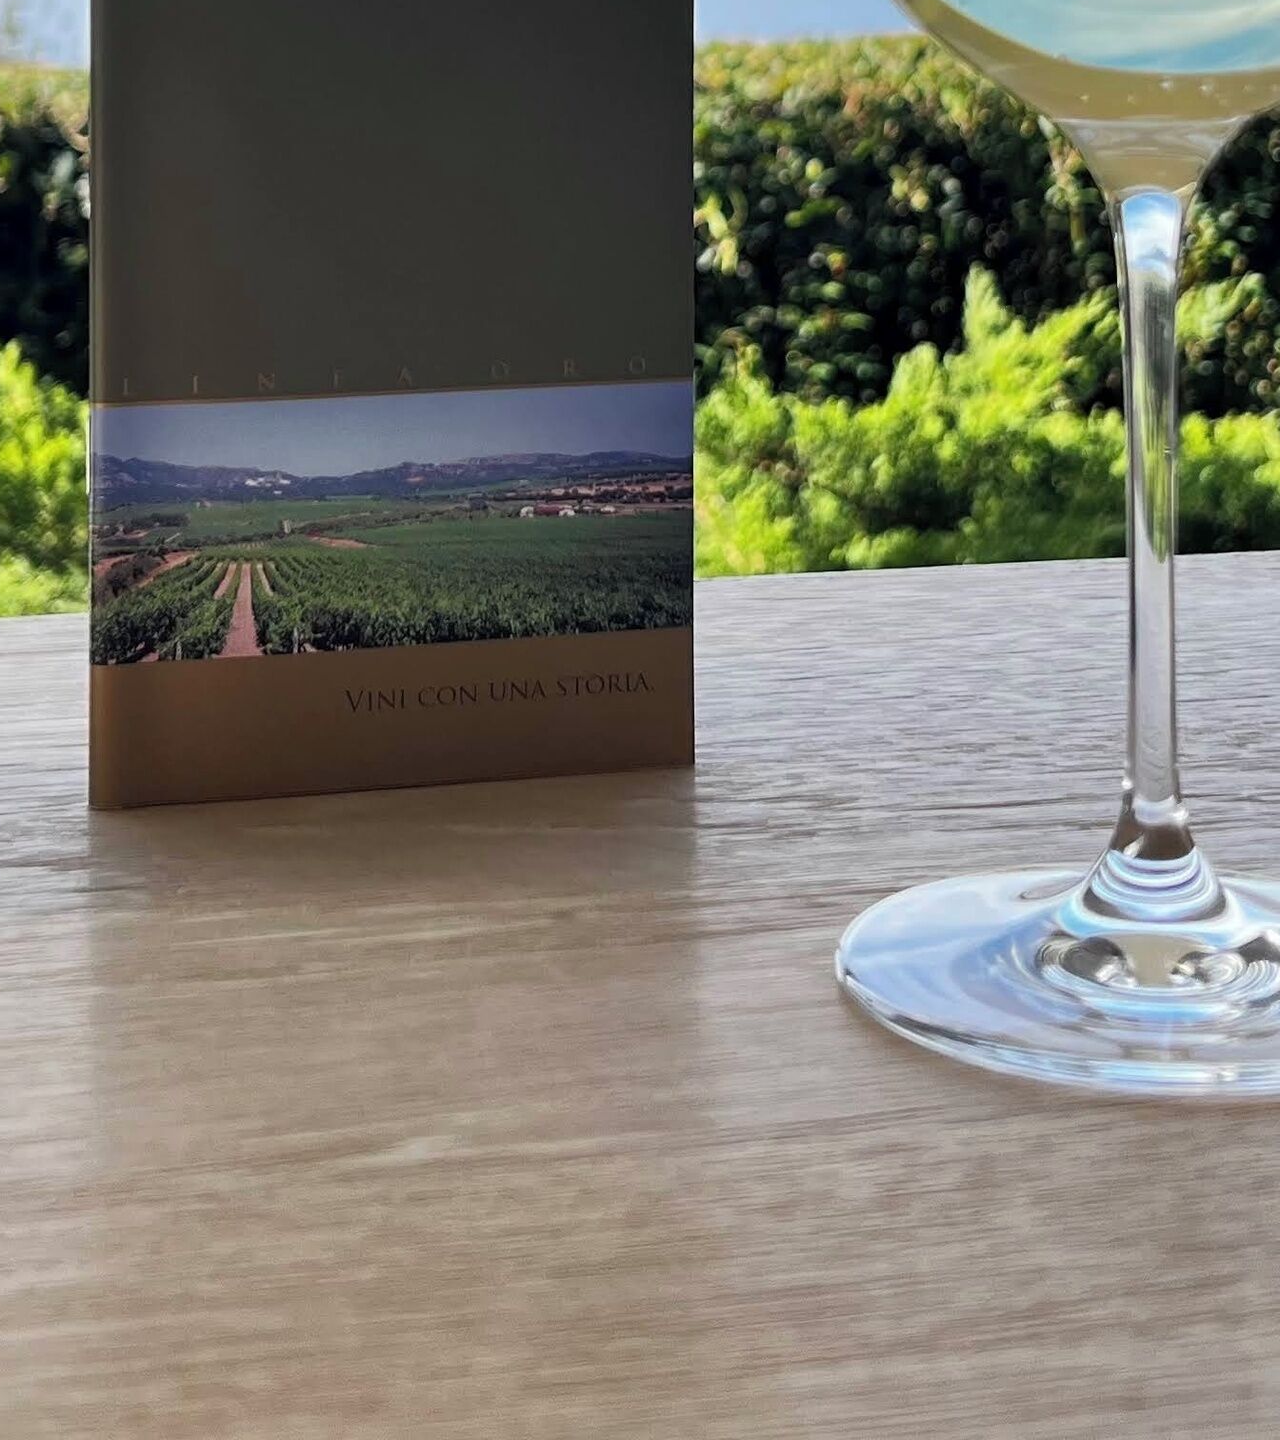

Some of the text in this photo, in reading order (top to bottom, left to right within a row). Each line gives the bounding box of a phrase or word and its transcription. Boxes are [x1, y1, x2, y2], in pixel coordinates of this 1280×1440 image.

[345, 688, 406, 712] VINI
[417, 682, 479, 707] CON
[488, 678, 547, 702] UNA
